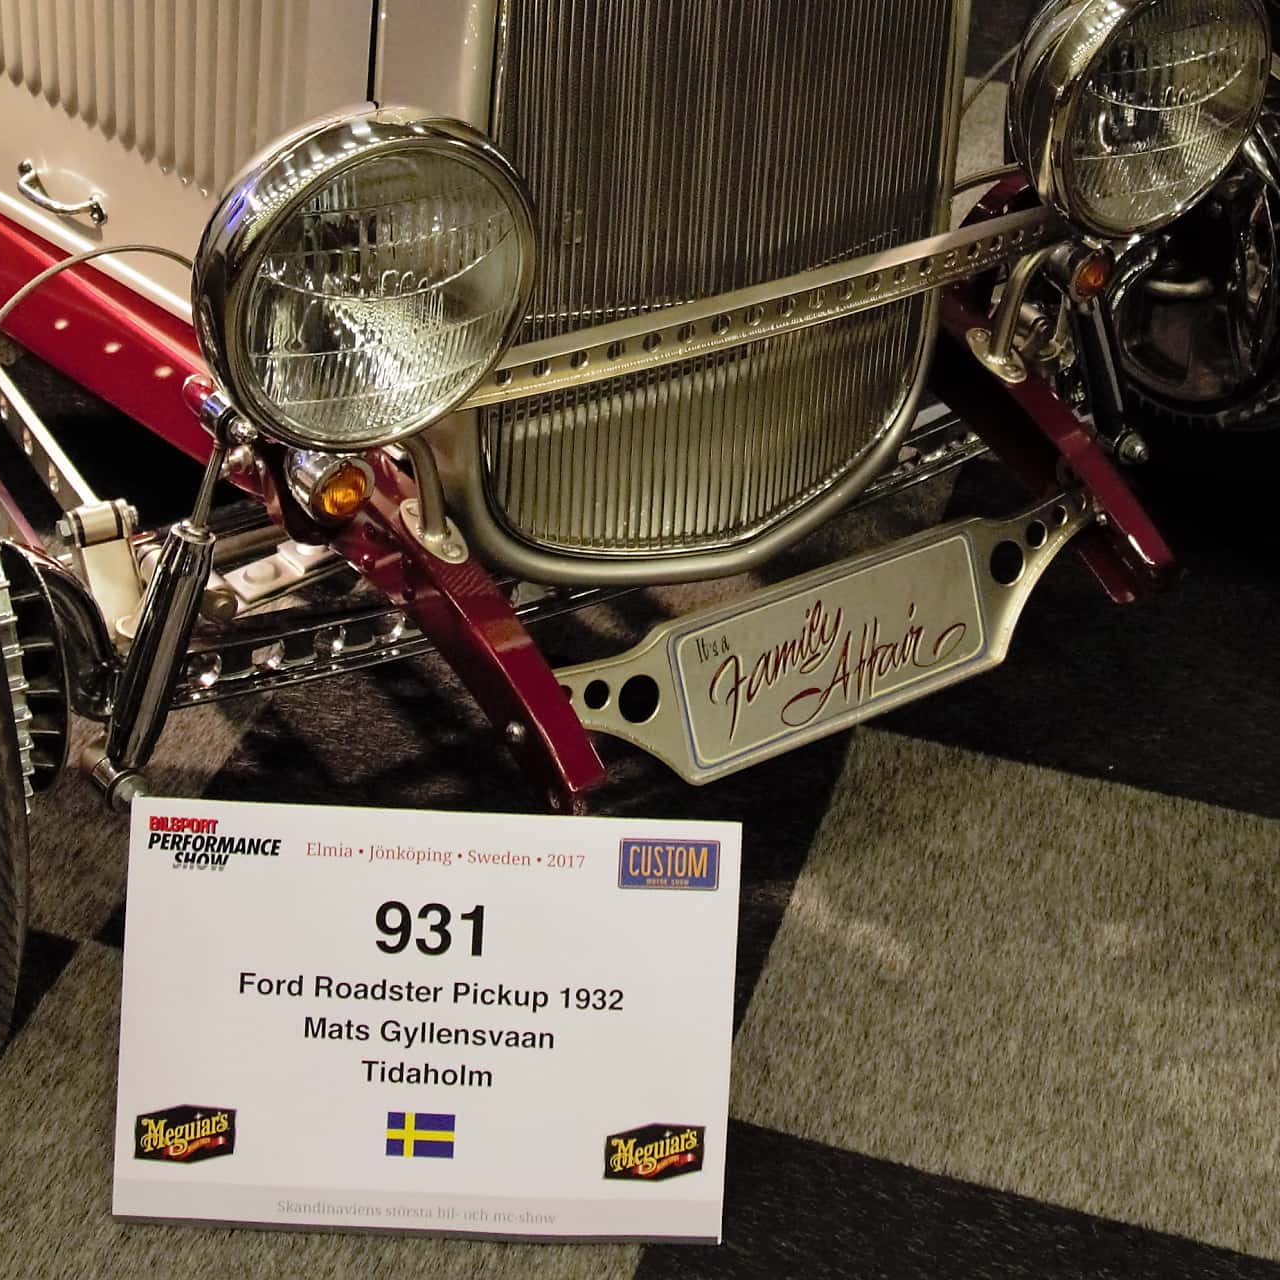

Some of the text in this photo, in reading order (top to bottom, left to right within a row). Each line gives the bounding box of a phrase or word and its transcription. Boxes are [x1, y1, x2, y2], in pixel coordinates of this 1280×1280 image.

[709, 599, 846, 741] Family
[781, 602, 968, 727] Affair
[148, 815, 218, 834] BILSPORT
[147, 832, 282, 857] PERFORMANCE
[172, 851, 230, 871] SHOW
[306, 841, 586, 869] Elmia Jönköping Sweden 2017
[628, 845, 708, 879] CUSTOM
[373, 900, 487, 958] 931
[238, 971, 625, 1012] Ford Roadster Pickup 1932
[303, 1016, 556, 1050] Mats Gyllensvaan
[361, 1060, 494, 1088] Tidaholm
[140, 1111, 229, 1157] Meguiar's
[609, 1128, 698, 1176] Meguiar's
[276, 1199, 382, 1218] Skandinaviens
[384, 1204, 433, 1219] största
[463, 1207, 489, 1222] och
